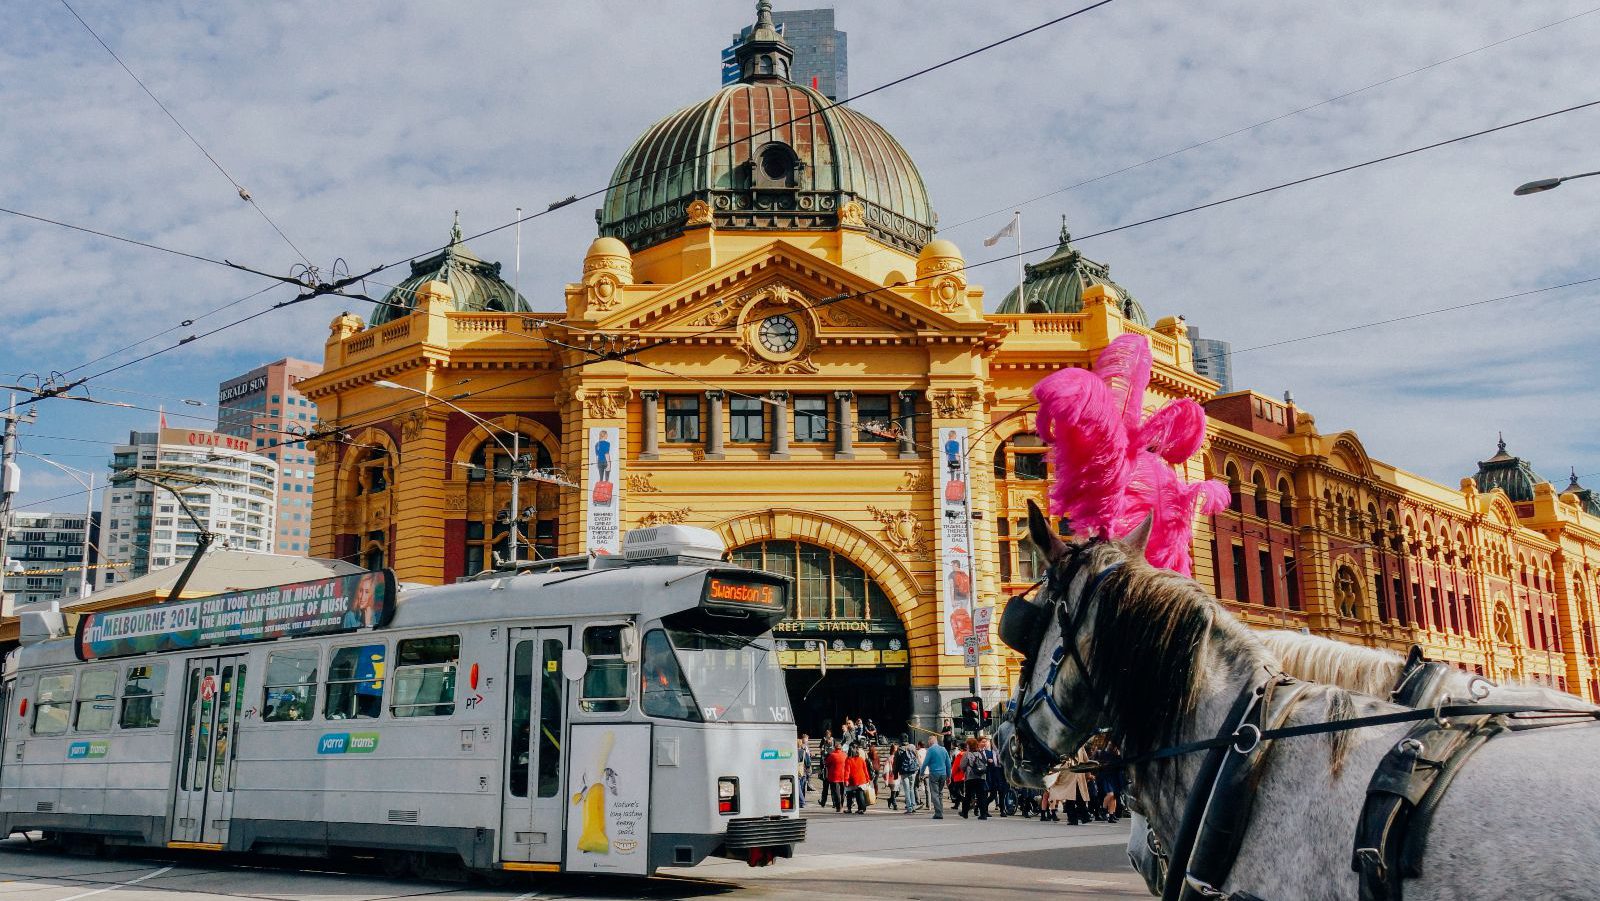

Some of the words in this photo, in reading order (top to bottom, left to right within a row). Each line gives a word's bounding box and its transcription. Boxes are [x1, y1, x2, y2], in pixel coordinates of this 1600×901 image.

[250, 377, 266, 391] SUN
[189, 432, 220, 446] QUAY
[226, 437, 249, 452] WEST
[202, 599, 226, 615] START
[227, 595, 249, 611] YOUR
[250, 590, 281, 608] CAREER
[281, 588, 294, 604] IN
[294, 584, 322, 602] MUSIC
[322, 582, 336, 598] AT
[711, 580, 759, 602] Swanston
[762, 586, 773, 604] St
[103, 611, 166, 637] MELBOURNE
[169, 606, 199, 630] 2014
[201, 614, 215, 630] THE
[216, 606, 264, 628] AUSTRALIAN
[265, 601, 306, 622] INSTITUTE
[306, 600, 320, 616] OF
[320, 596, 350, 615] MUSIC
[773, 622, 806, 632] TREET
[818, 621, 868, 632] STATION
[769, 706, 789, 722] 167
[70, 746, 87, 757] yarra
[322, 738, 344, 752] yarra
[351, 737, 375, 748] trams
